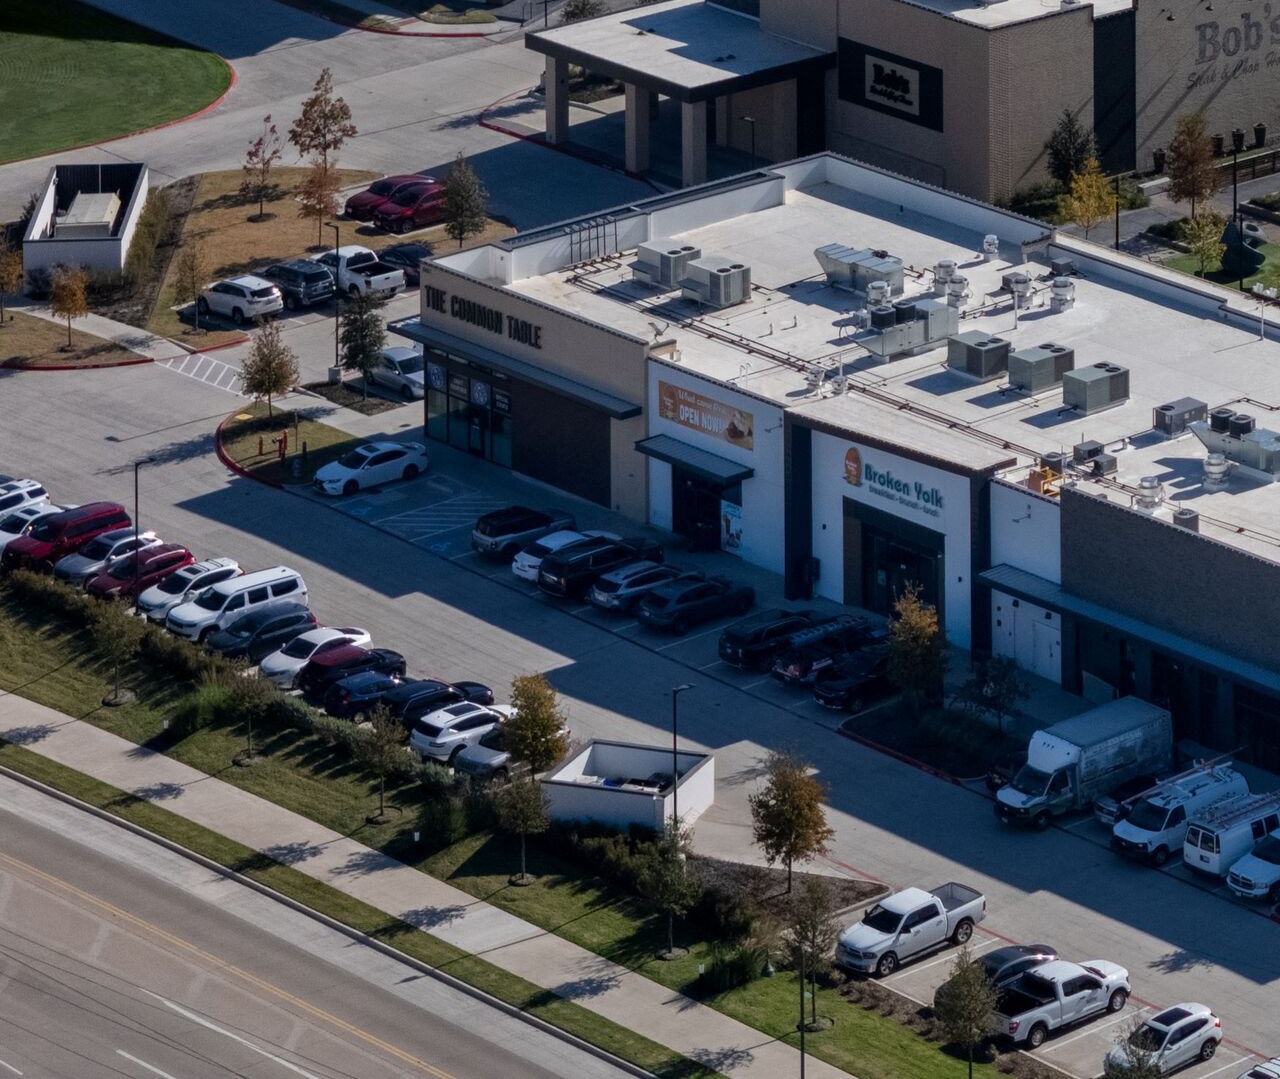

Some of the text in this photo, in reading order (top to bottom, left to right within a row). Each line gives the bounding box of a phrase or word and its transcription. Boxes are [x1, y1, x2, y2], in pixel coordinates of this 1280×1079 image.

[424, 285, 542, 349] THE COMMON TABLE
[680, 404, 699, 426] OPEN
[865, 463, 909, 496] Broken
[914, 482, 943, 509] Yolk
